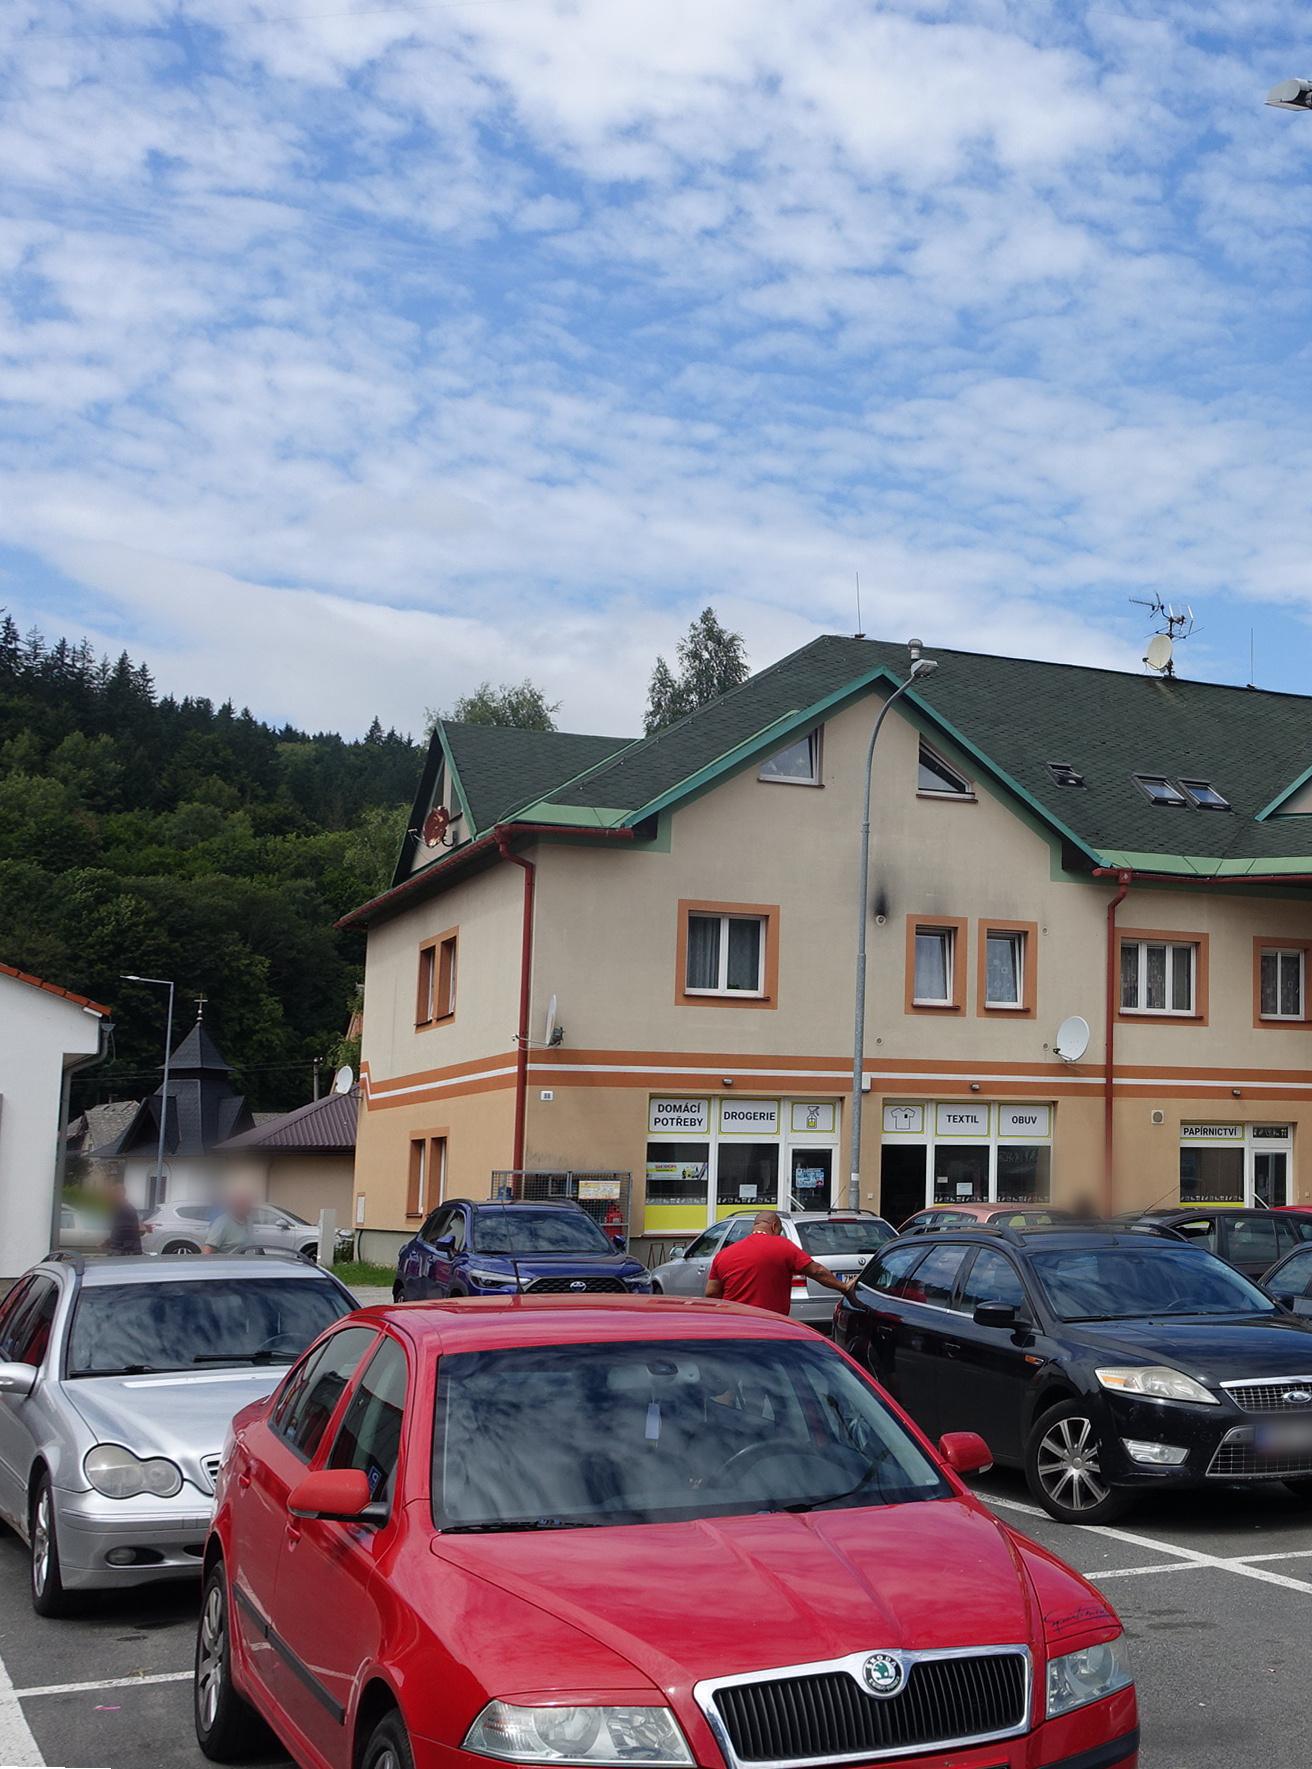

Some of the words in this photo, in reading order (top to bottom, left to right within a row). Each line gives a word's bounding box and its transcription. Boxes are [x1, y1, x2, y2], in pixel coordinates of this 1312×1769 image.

[657, 1102, 701, 1114] DOMÁCÍ
[653, 1115, 704, 1128] POTŘEBY
[723, 1110, 776, 1122] DROGERIE
[946, 1113, 979, 1124] TEXTIL
[1011, 1115, 1037, 1125] OBUV
[1183, 1126, 1237, 1136] PAPÍRNICTVÍ
